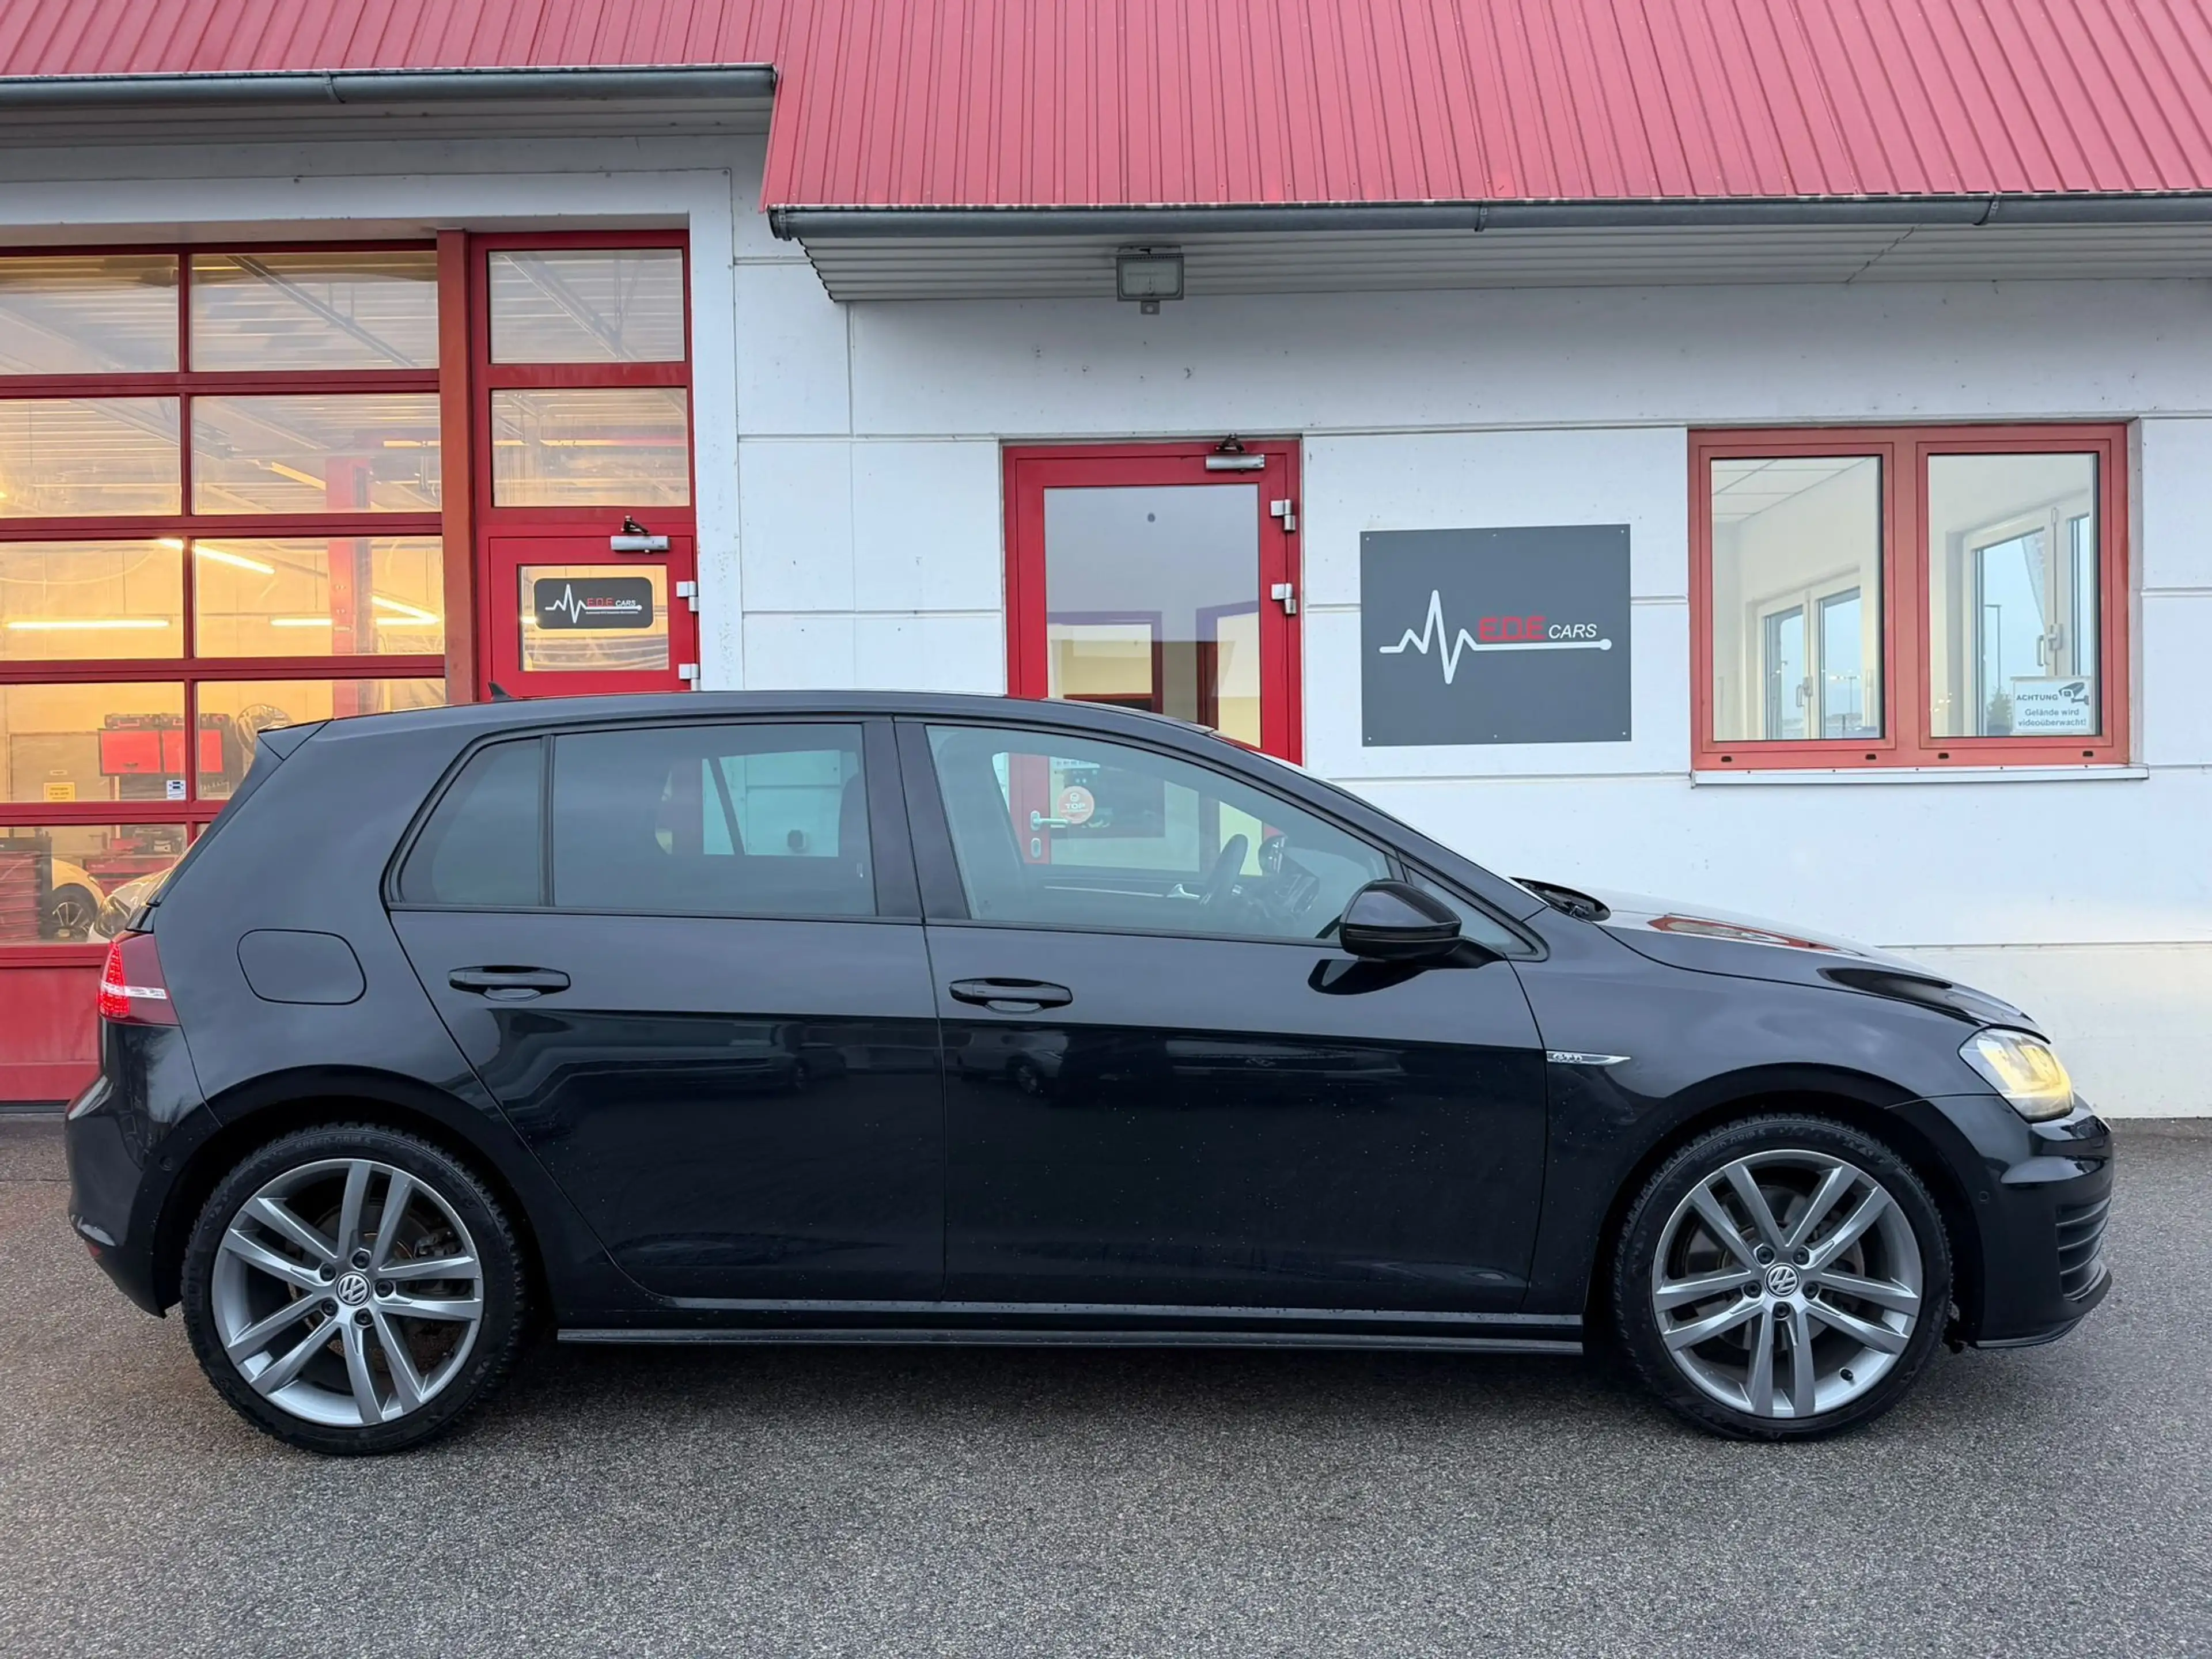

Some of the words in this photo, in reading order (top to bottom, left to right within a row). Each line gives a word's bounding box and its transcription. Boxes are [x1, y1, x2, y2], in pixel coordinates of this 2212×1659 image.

[1548, 623, 1597, 639] CARS
[2024, 708, 2059, 717] Gelände
[2061, 708, 2080, 716] wird
[2018, 718, 2086, 726] videoüberwacht!
[1768, 1266, 1797, 1295] VW
[338, 1275, 368, 1305] VW
